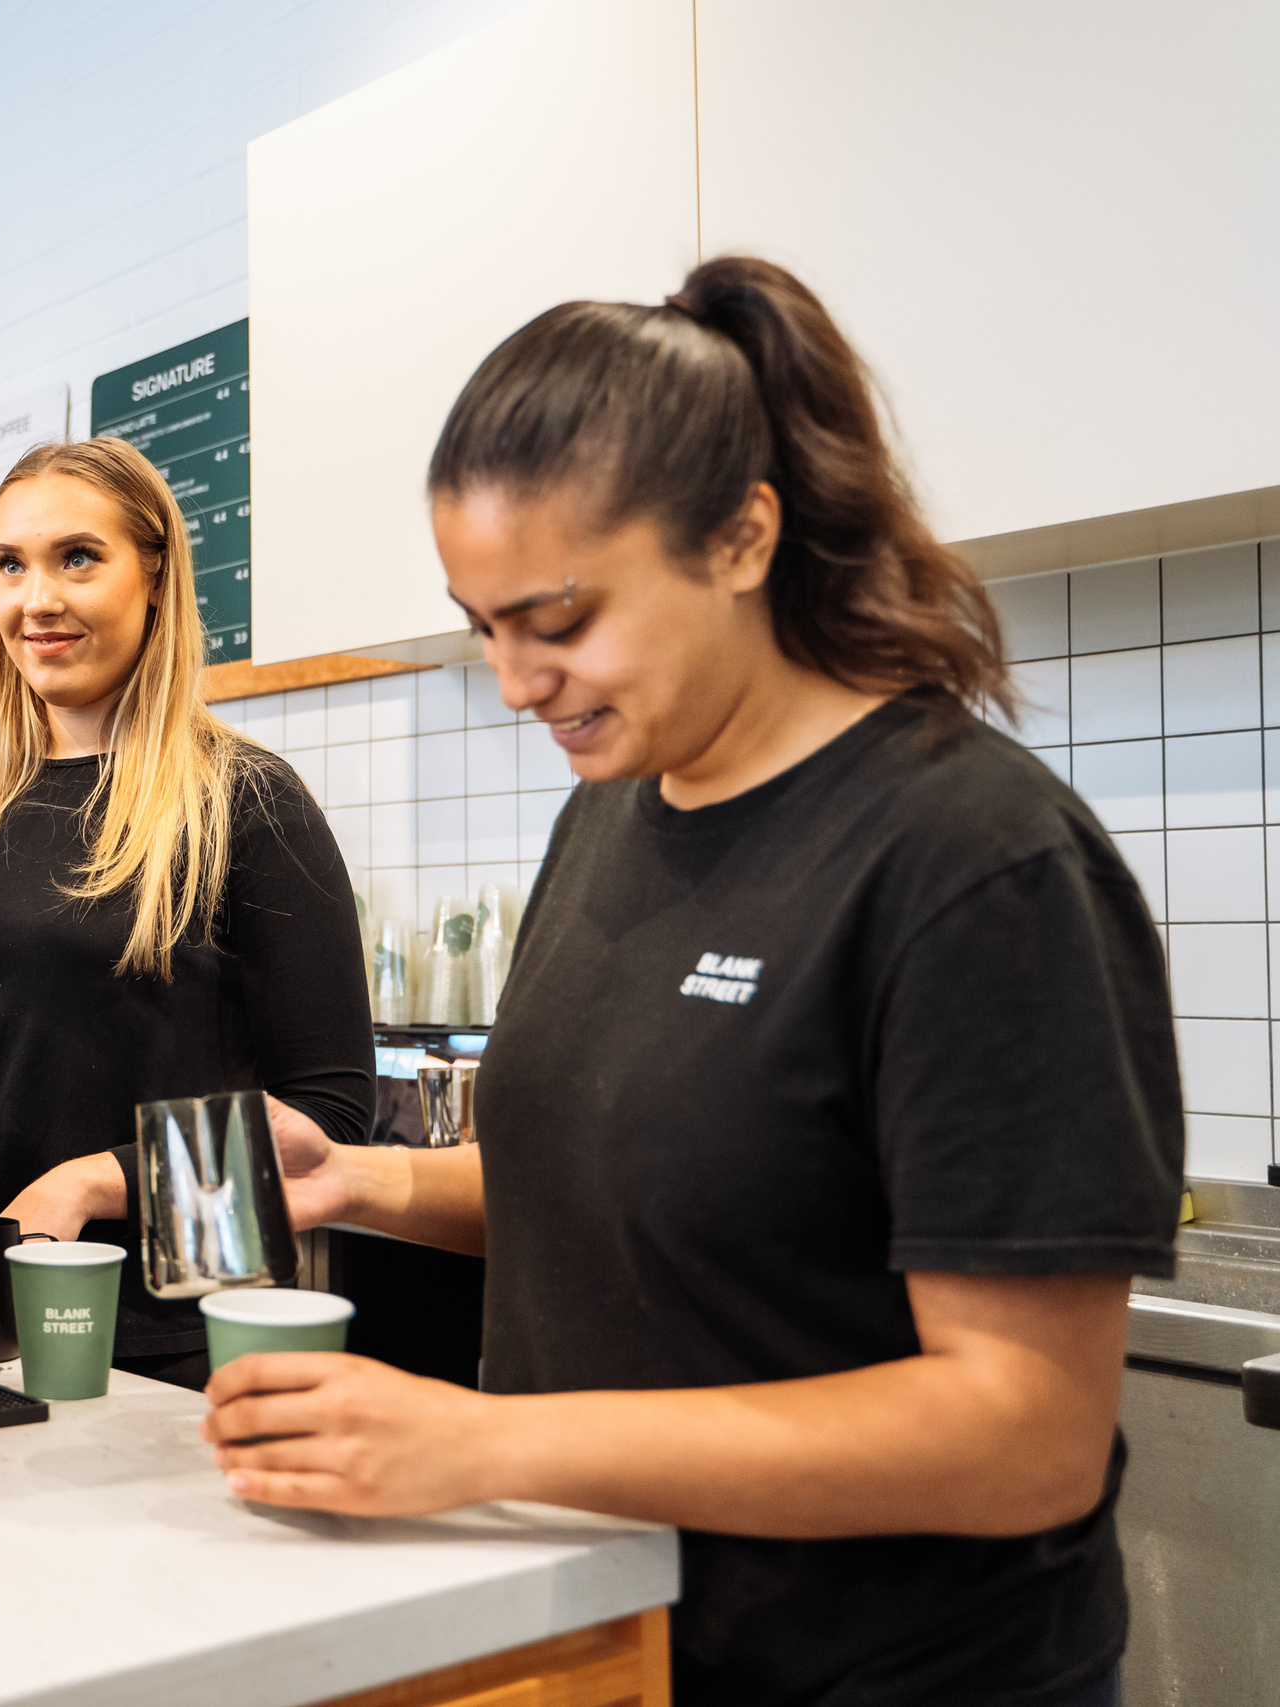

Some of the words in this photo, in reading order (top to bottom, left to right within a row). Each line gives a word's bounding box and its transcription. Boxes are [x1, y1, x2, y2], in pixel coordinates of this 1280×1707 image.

[131, 352, 216, 402] SIGNATURE
[696, 951, 765, 980] BLANK
[680, 973, 758, 1005] STREET
[42, 1321, 95, 1334] STREET
[44, 1307, 91, 1320] BLANK
